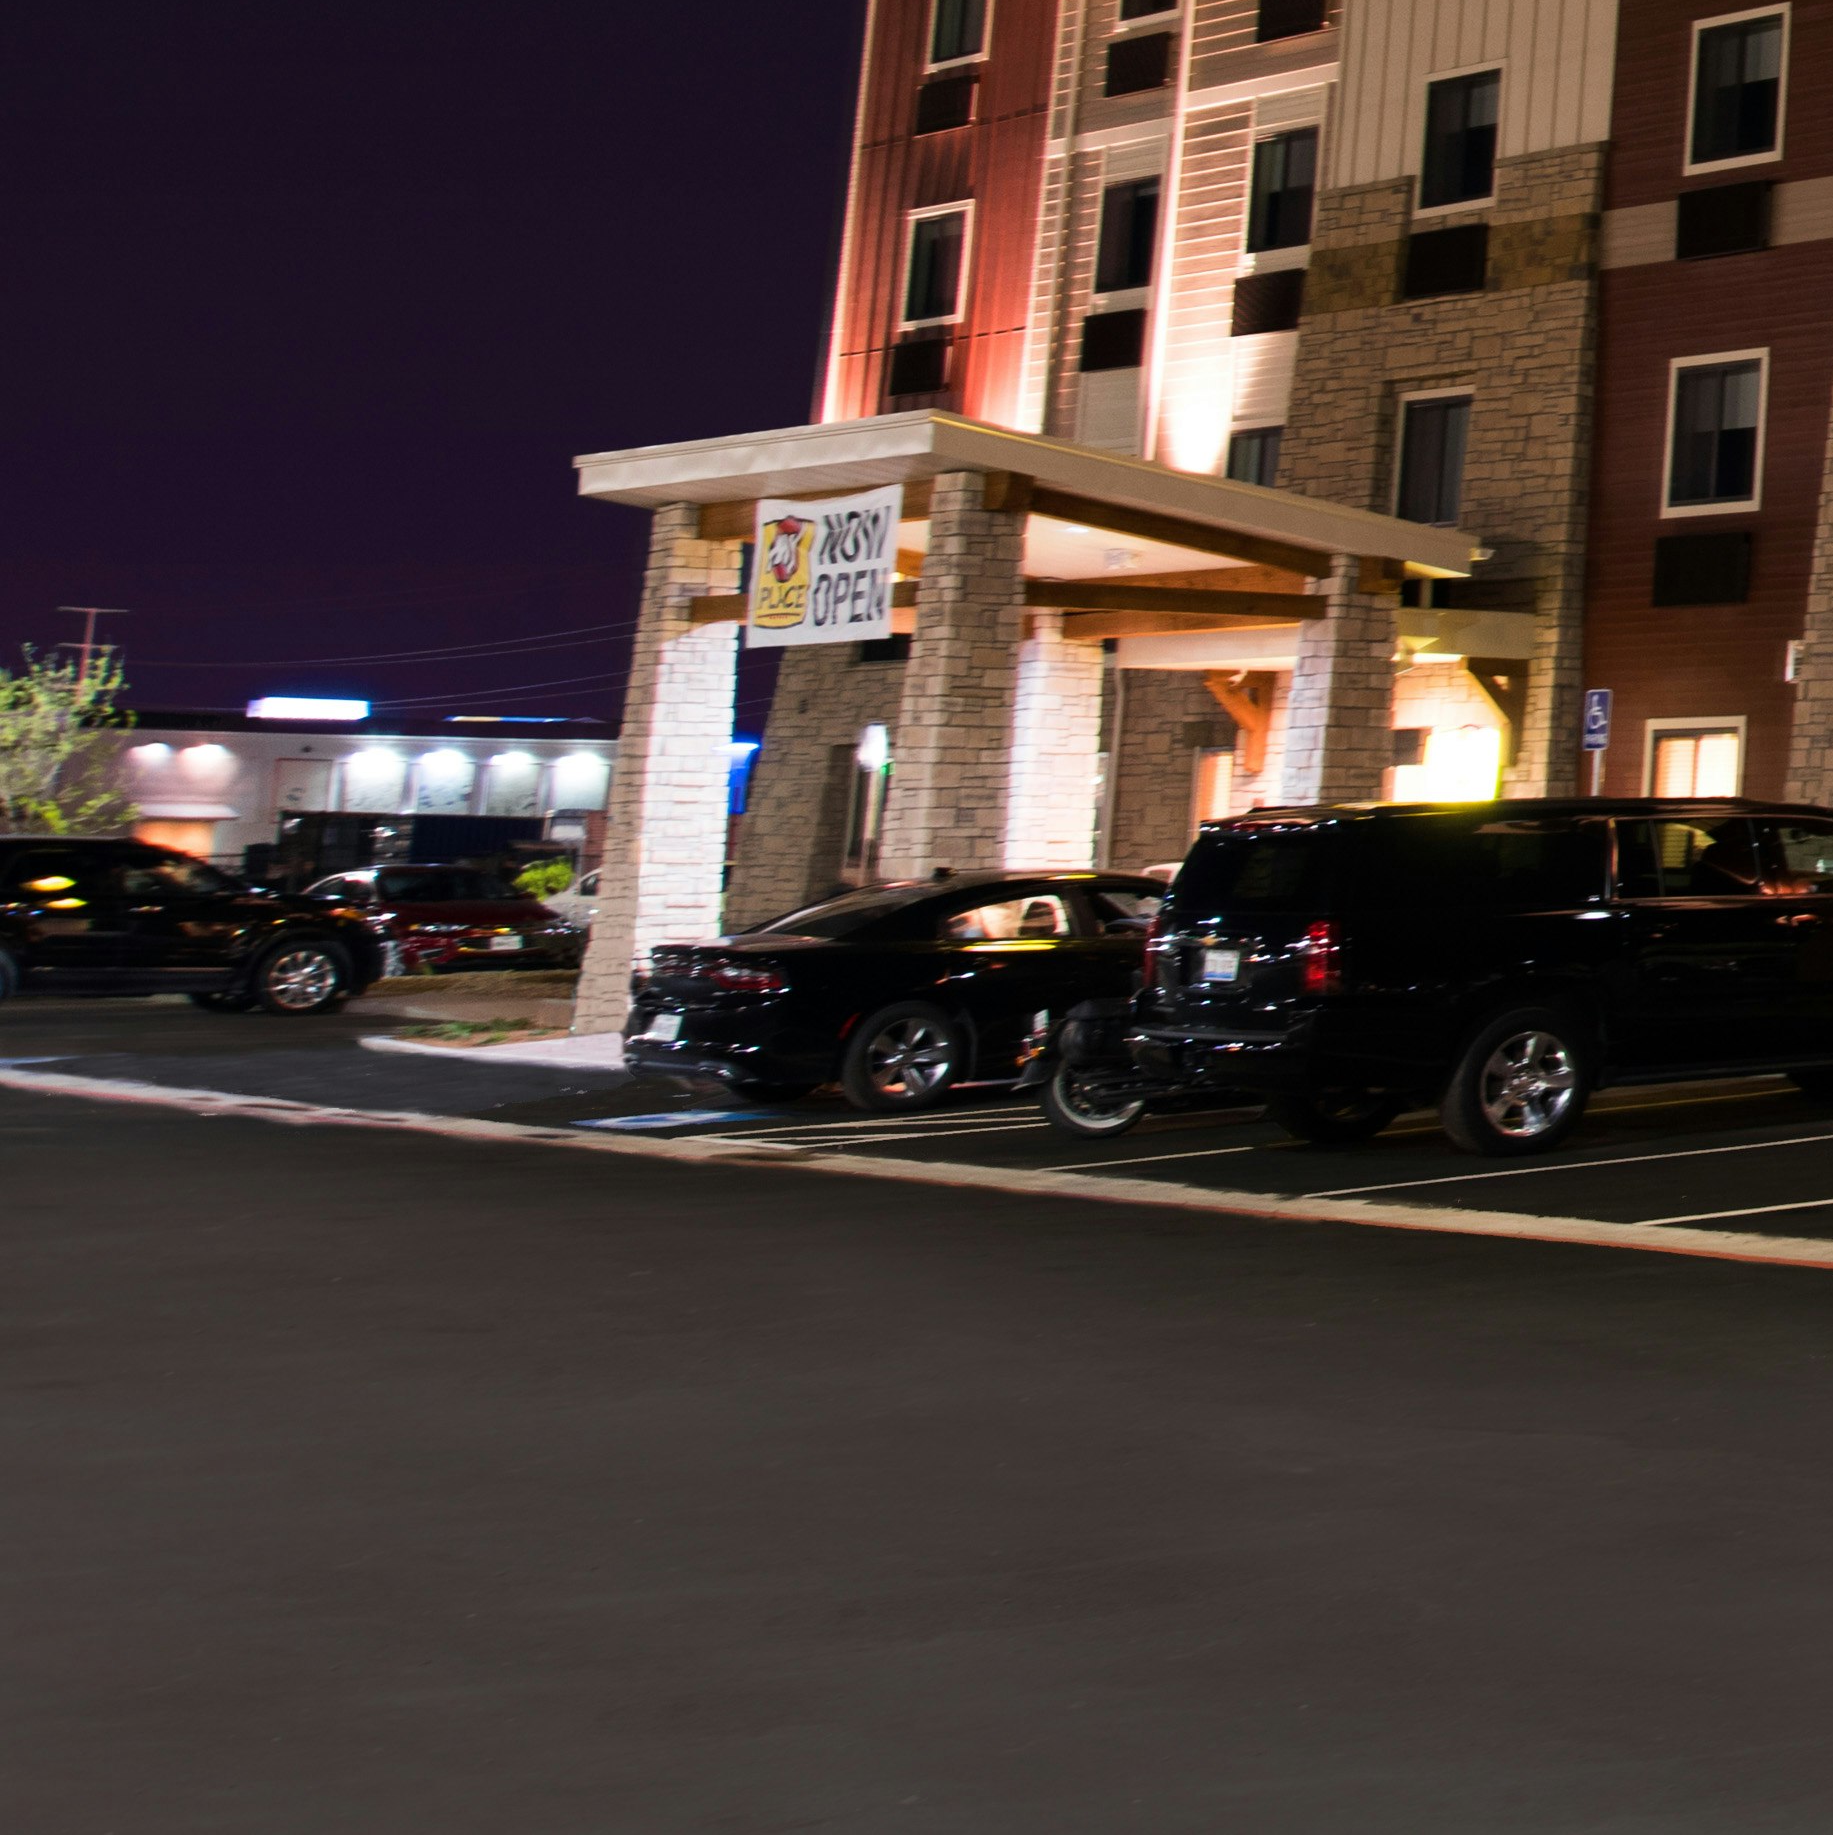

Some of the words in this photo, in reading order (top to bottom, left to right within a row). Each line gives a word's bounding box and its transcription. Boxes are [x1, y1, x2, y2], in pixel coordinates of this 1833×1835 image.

[818, 504, 893, 565] NOW
[757, 584, 808, 610] PLACE
[812, 566, 889, 627] OPEN
